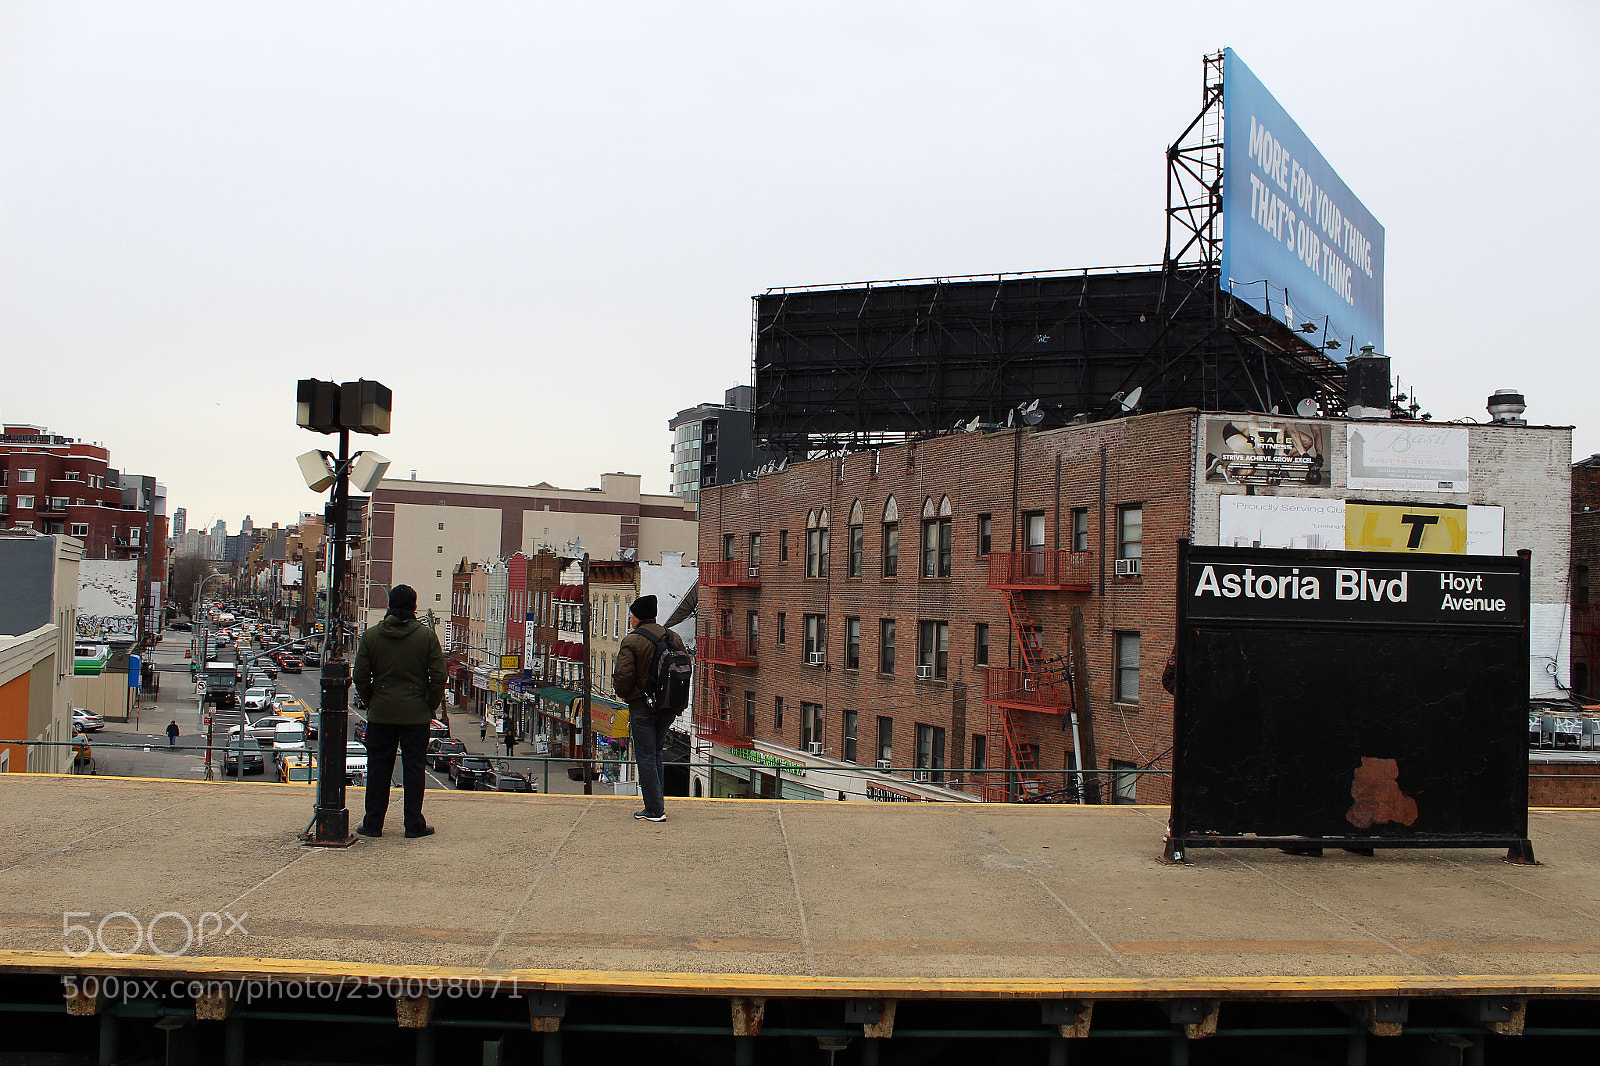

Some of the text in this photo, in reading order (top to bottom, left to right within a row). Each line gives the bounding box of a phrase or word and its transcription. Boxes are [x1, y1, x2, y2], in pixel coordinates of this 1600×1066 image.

[1248, 115, 1373, 279] MORE FOR YOUR THING.
[1249, 172, 1354, 307] THAT'S OUR THING.
[1371, 429, 1453, 453] Basil
[1280, 504, 1324, 514] Serving
[1194, 565, 1408, 603] Astoria Blvd
[1440, 572, 1483, 594] Hoyt
[1440, 593, 1507, 612] Avenue
